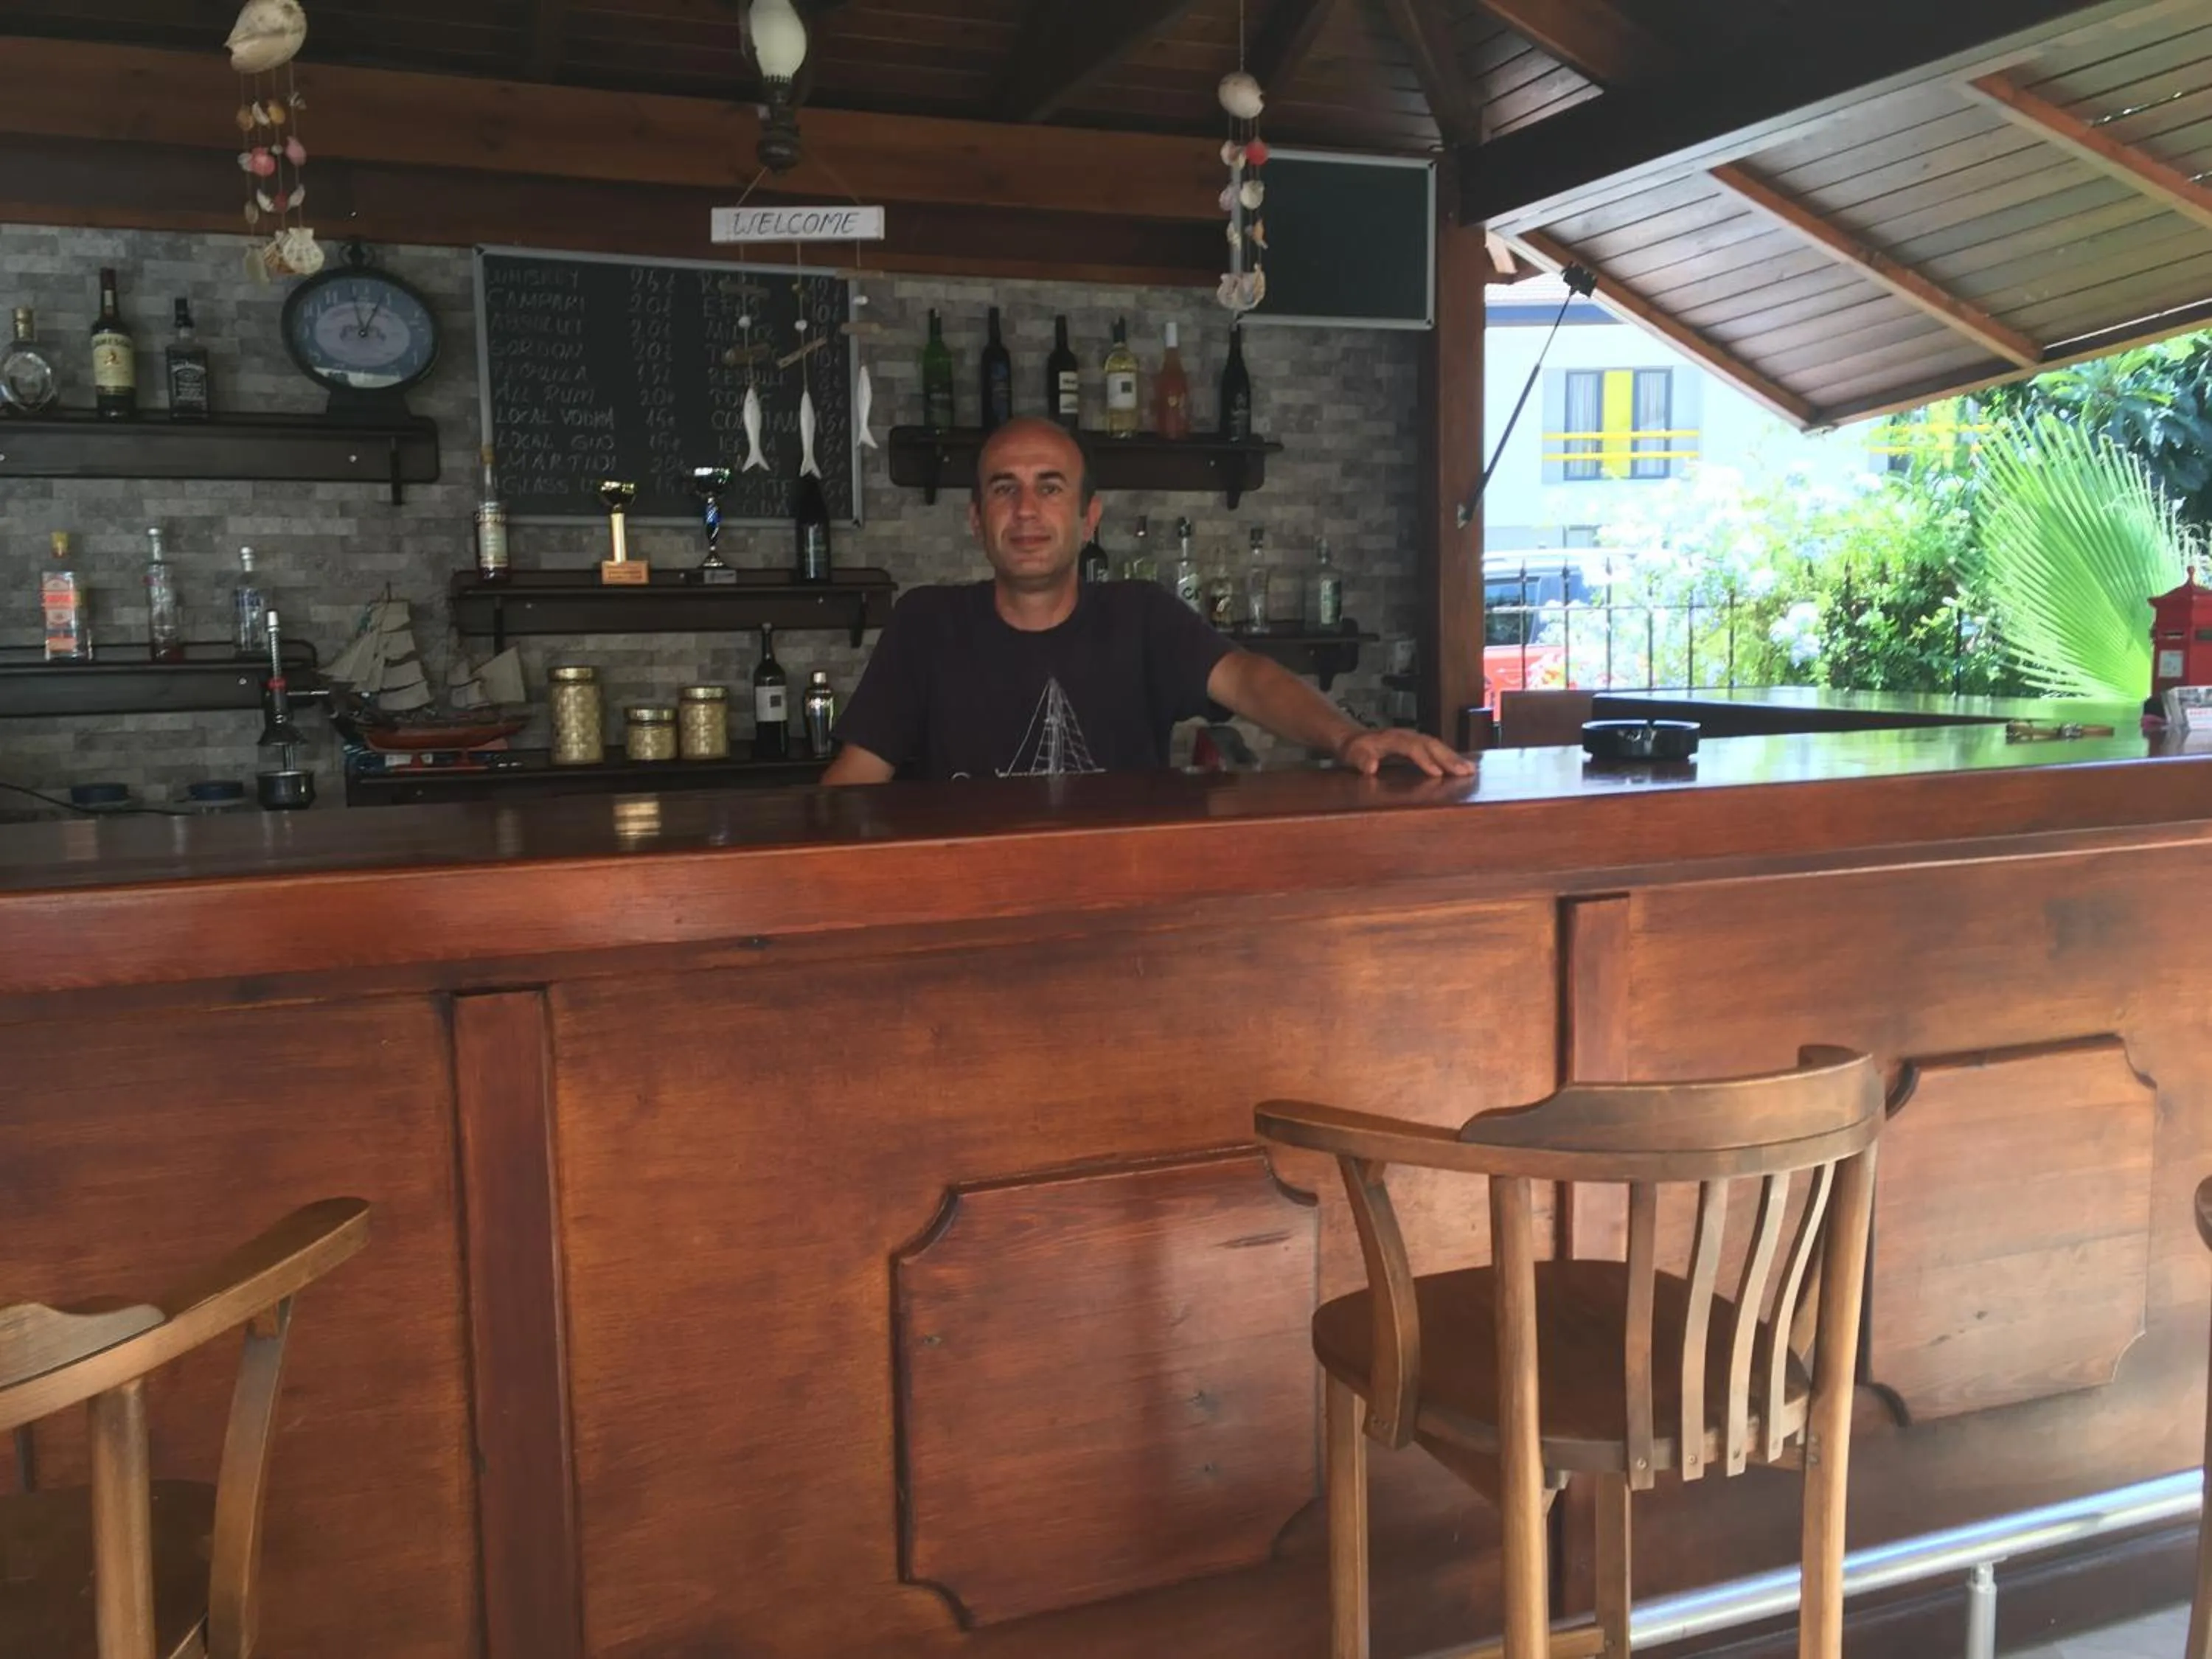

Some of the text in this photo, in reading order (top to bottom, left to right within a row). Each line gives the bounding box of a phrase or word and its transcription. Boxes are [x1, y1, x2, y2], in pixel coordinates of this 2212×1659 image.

[733, 212, 860, 235] WELCOME
[709, 388, 773, 409] TOC
[495, 406, 554, 425] LOCAL
